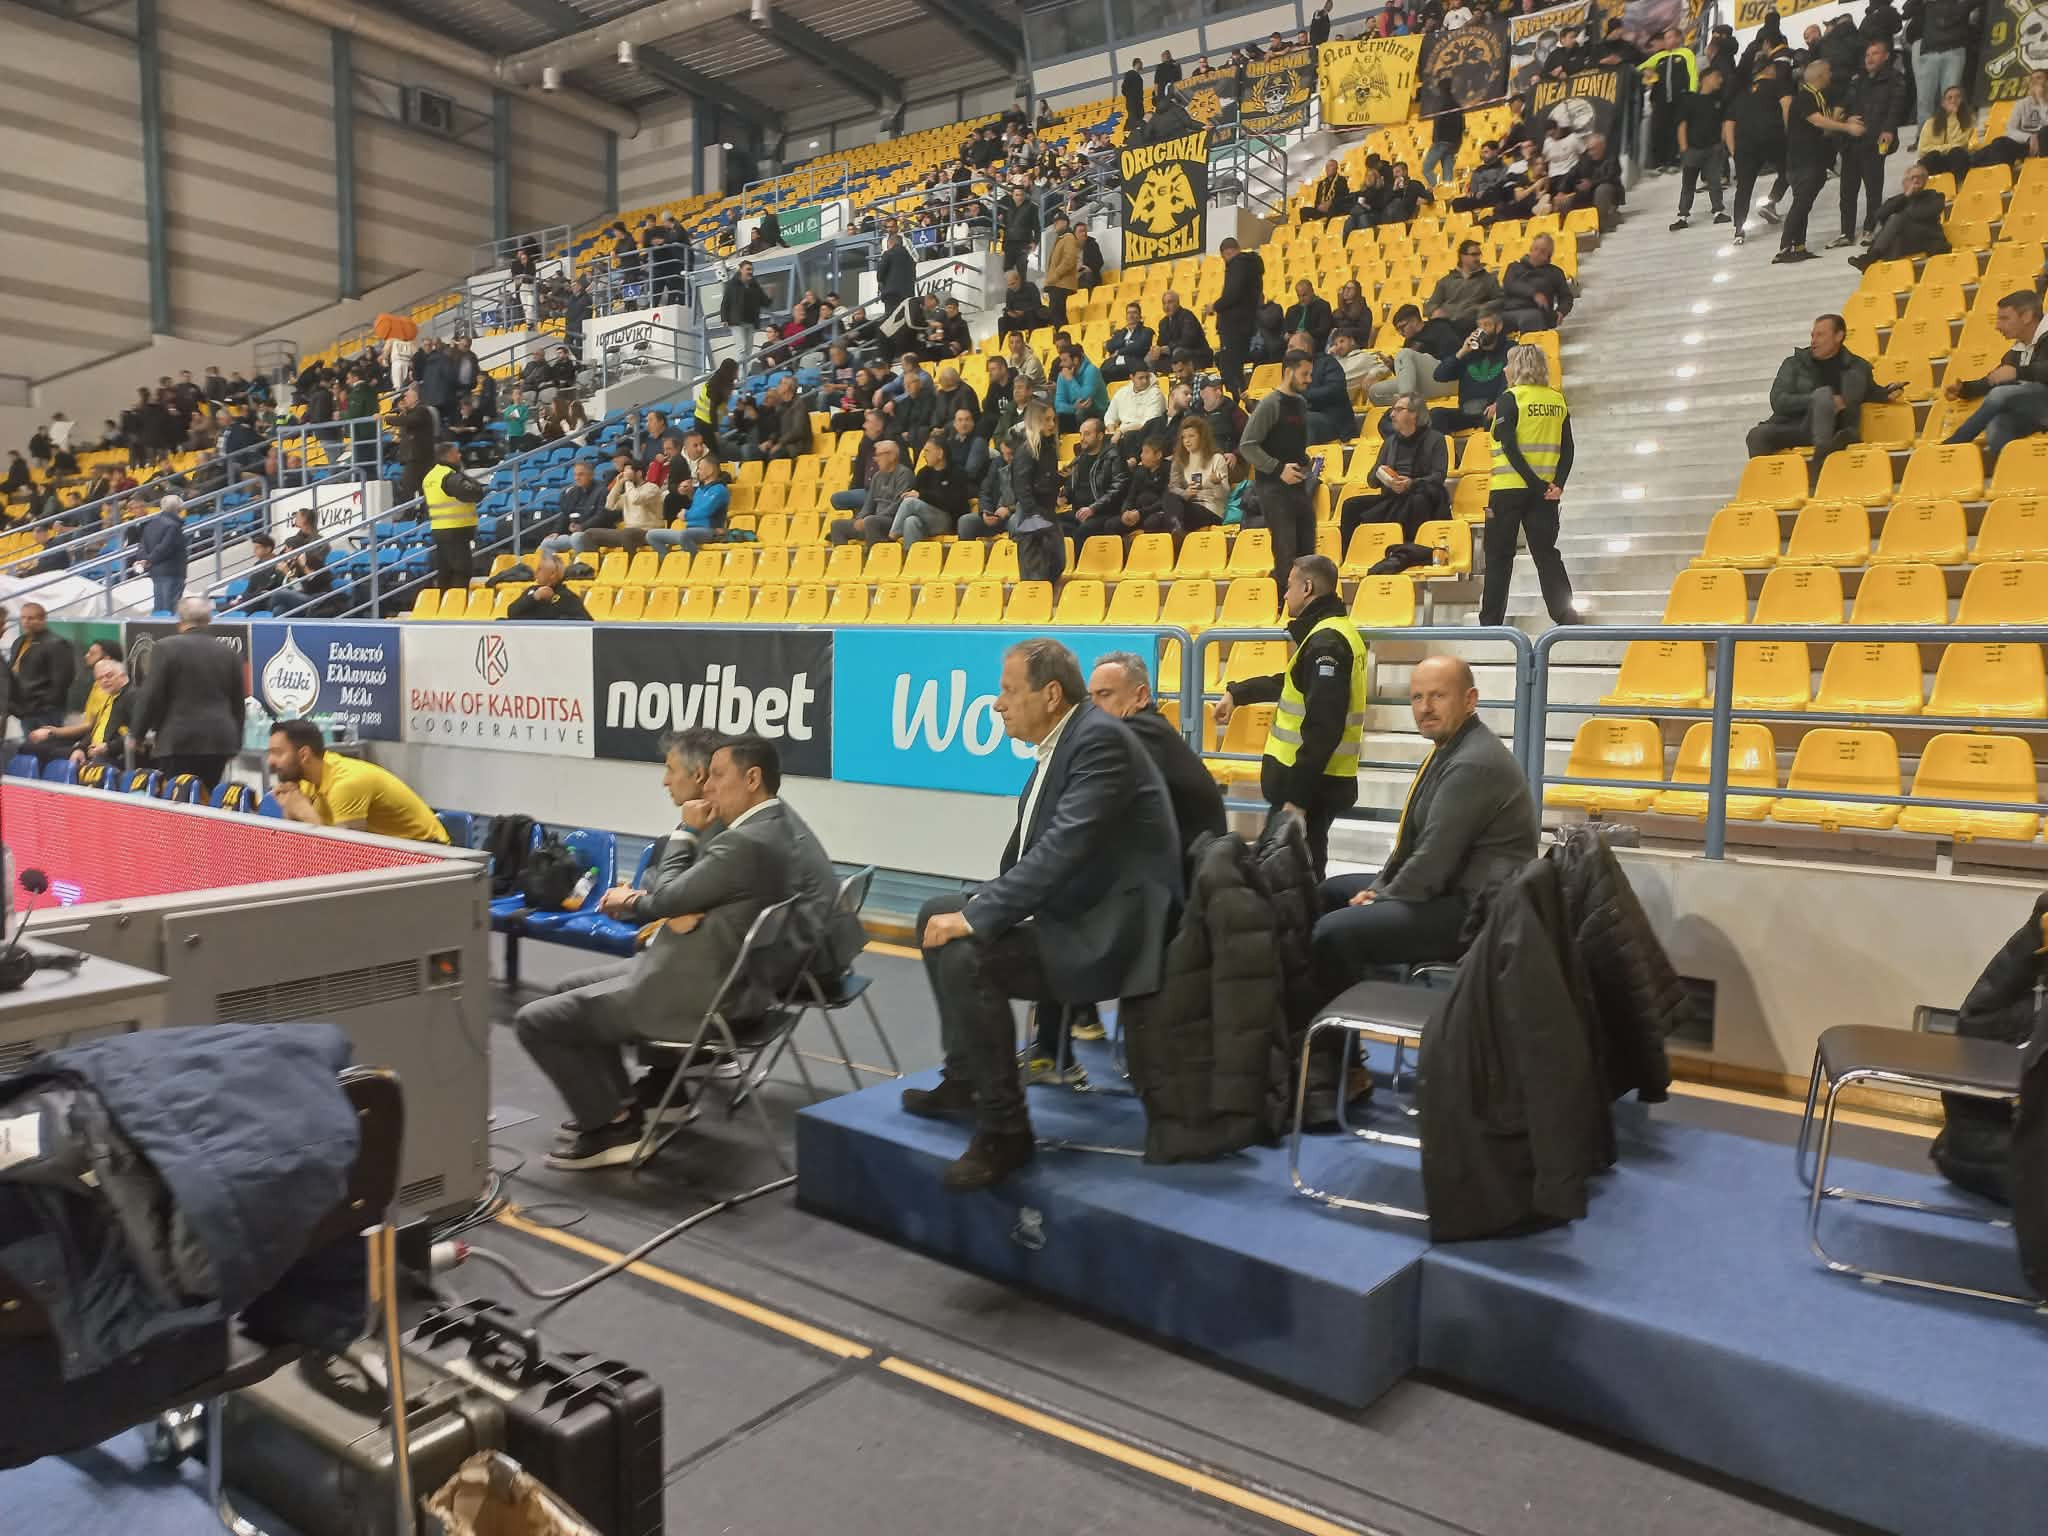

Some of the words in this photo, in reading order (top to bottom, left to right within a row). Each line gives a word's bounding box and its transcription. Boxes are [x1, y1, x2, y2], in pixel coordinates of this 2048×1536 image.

[1323, 45, 1352, 67] Nea
[1534, 80, 1567, 115] NEA
[1347, 111, 1370, 122] Club
[1121, 130, 1208, 181] ORIGINAL
[1125, 214, 1200, 263] KIPSELI
[328, 641, 384, 663] Εκλεκτό
[269, 667, 311, 691] Attiki
[326, 663, 387, 686] Ελληνικό
[340, 686, 373, 707] Μέλι
[411, 688, 456, 713] BANK
[461, 692, 483, 715] OF
[488, 694, 584, 723] KARDITSA
[605, 663, 815, 742] novibet
[410, 717, 584, 745] COOPERATIVE
